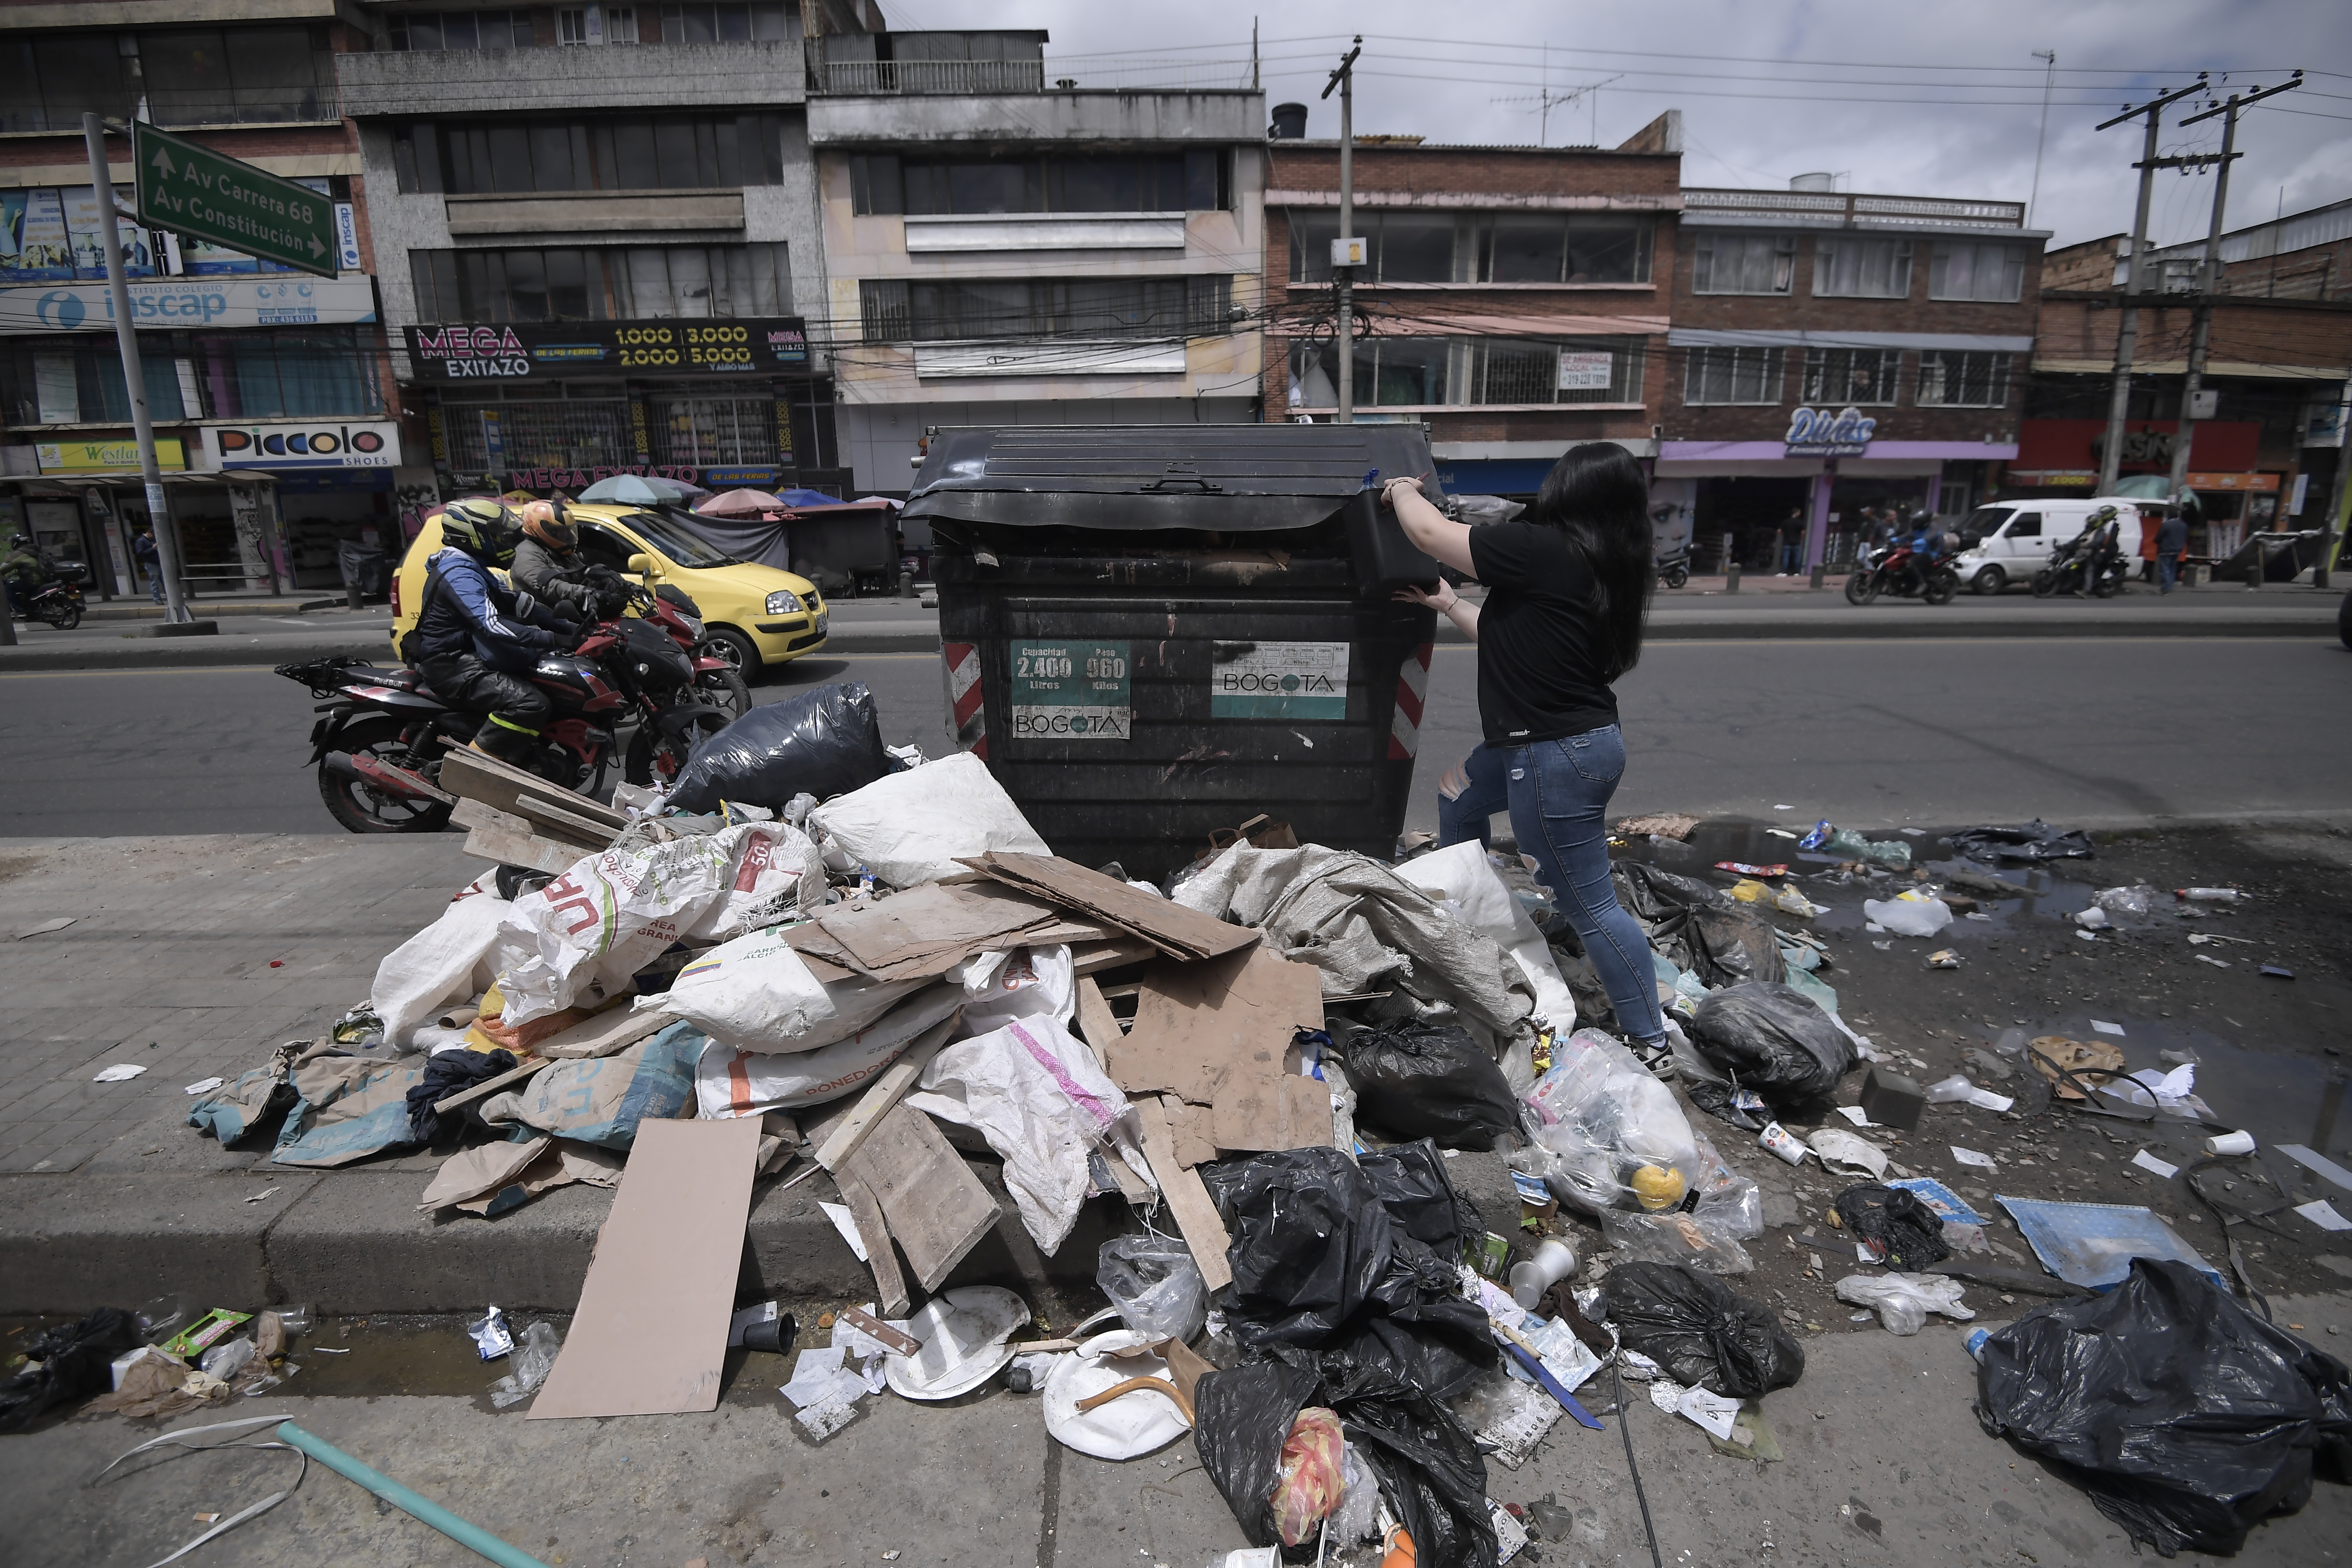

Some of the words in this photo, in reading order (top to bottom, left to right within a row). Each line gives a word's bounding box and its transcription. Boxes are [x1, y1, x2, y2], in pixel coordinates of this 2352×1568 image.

[185, 162, 211, 188] Av
[218, 174, 284, 215] Carrera
[290, 201, 313, 224] 68
[155, 186, 182, 213] Av
[190, 198, 303, 251] Constitución
[341, 207, 352, 245] inscap
[128, 286, 172, 294] STITUTO
[176, 285, 222, 293] COLEGIO
[416, 326, 528, 359] MEGA
[615, 327, 673, 345] 1.000
[687, 326, 748, 343] 3.000
[768, 331, 805, 343] MEGA
[620, 348, 680, 366] 2.000
[691, 347, 751, 364] 5.000
[446, 358, 530, 378] EXITAZO
[1787, 408, 1877, 443] Divas
[217, 426, 385, 457] Piccolo
[346, 457, 388, 465] SHOES
[512, 467, 589, 489] MEGA
[1022, 647, 1067, 656] Capacidad
[1017, 657, 1072, 678] 2.400
[1086, 657, 1125, 678] 960
[1030, 680, 1060, 689] Litros
[1092, 681, 1119, 690] Kilos
[637, 927, 679, 942] GRAN
[650, 919, 676, 932] REA
[806, 1050, 902, 1095] PONEDORA
